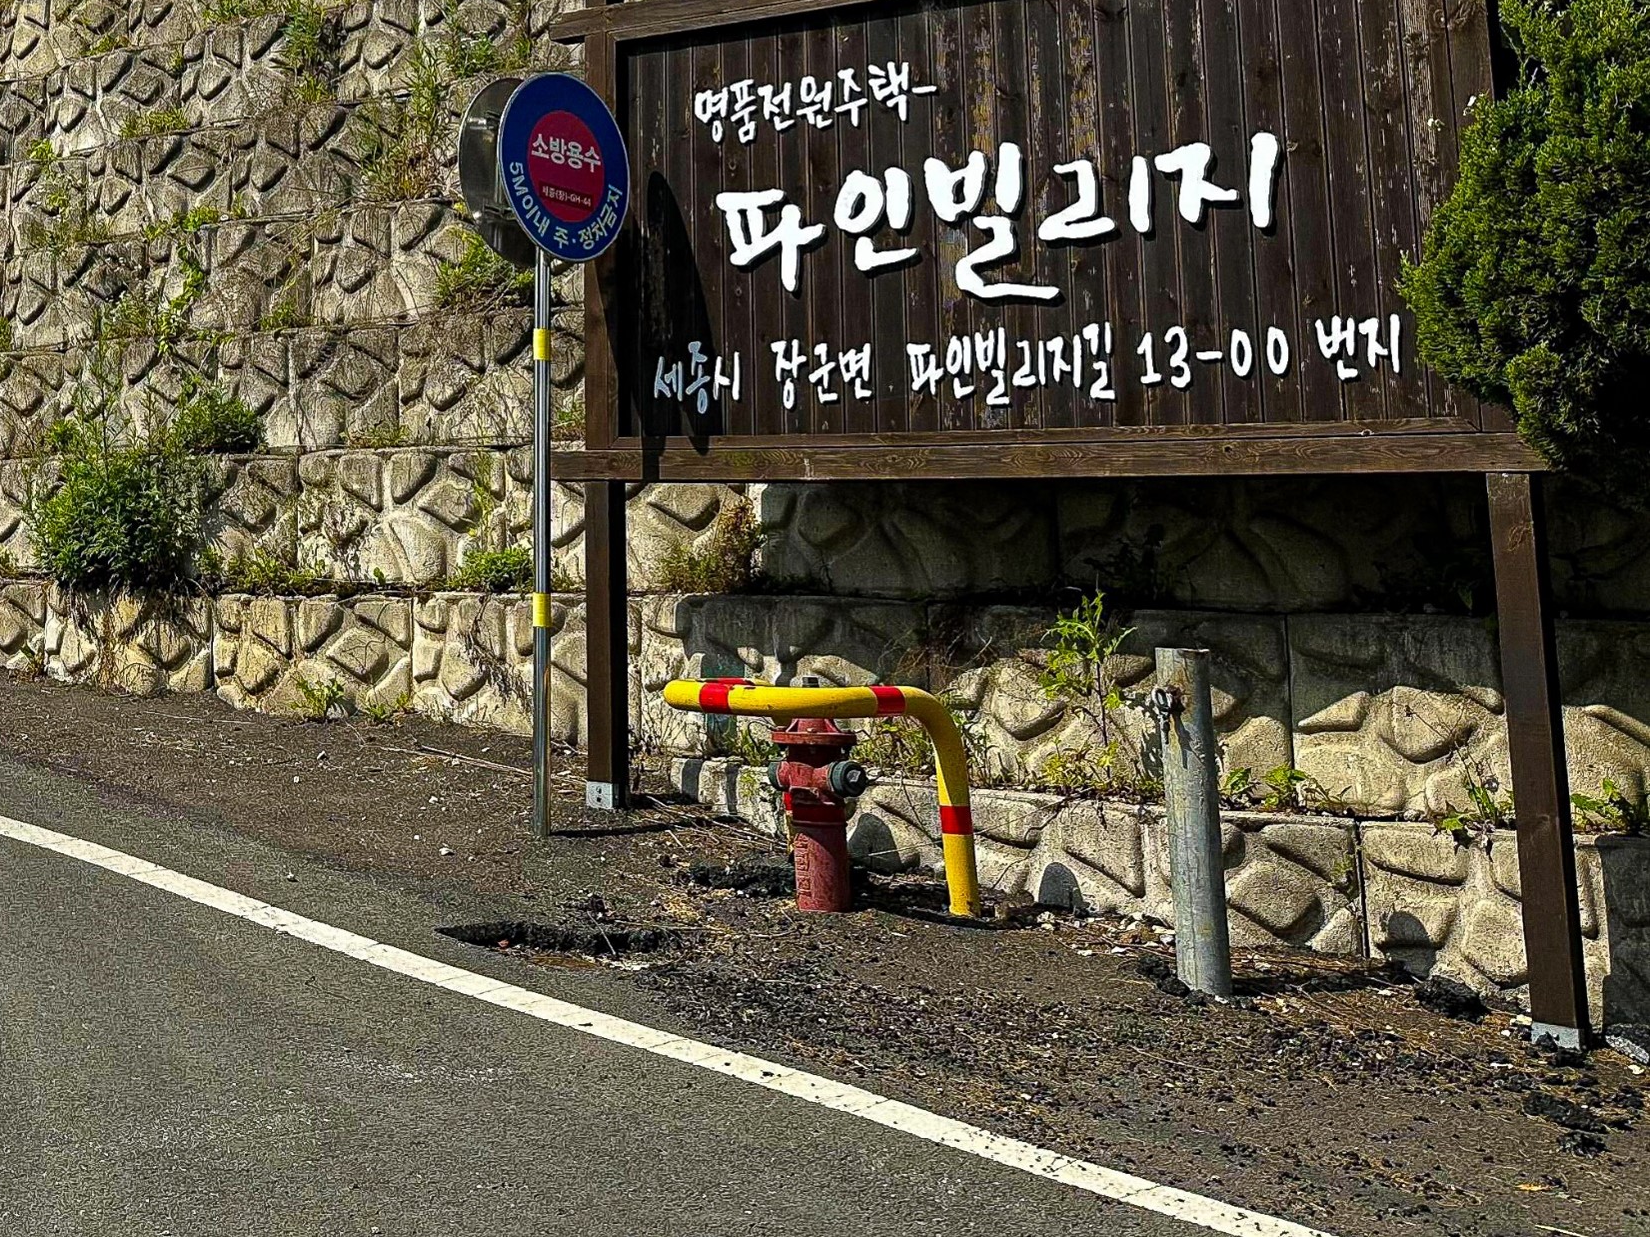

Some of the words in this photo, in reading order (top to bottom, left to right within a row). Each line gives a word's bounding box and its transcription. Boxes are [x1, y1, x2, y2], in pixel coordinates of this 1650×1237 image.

[531, 133, 602, 174] 소방용수
[509, 161, 551, 238] 5M이내
[714, 132, 1279, 300] 파인빌리지
[653, 340, 741, 415] 세종시
[770, 338, 872, 410] 장군면
[906, 321, 1116, 405] 파인빌리지길
[1136, 325, 1290, 388] 13-00
[1314, 313, 1400, 381] 번지
